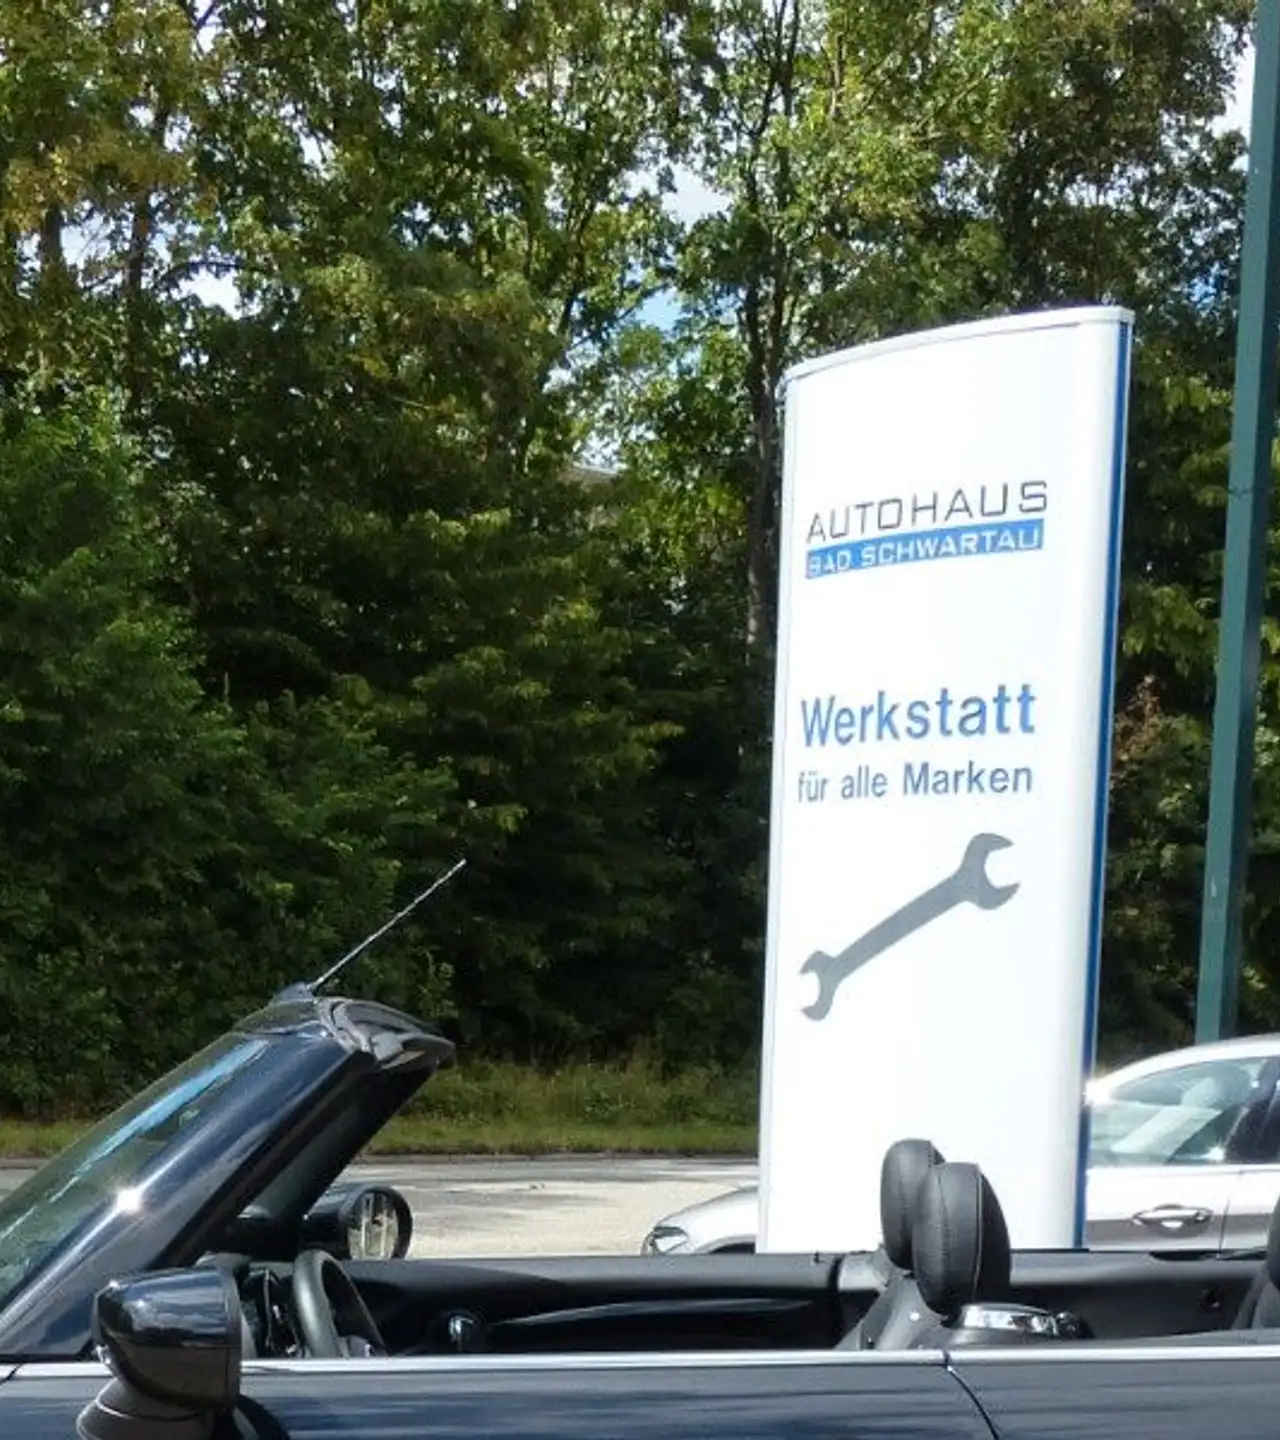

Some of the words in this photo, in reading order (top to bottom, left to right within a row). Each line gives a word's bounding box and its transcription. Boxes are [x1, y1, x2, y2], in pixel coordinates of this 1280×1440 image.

[805, 480, 1048, 544] AUTOHAUS
[809, 549, 852, 576] BAD
[861, 528, 1039, 566] SCHWARTAU
[800, 684, 1036, 748] Werkstatt
[798, 770, 828, 803] für
[840, 764, 888, 799] alle
[902, 759, 1033, 796] Marken
